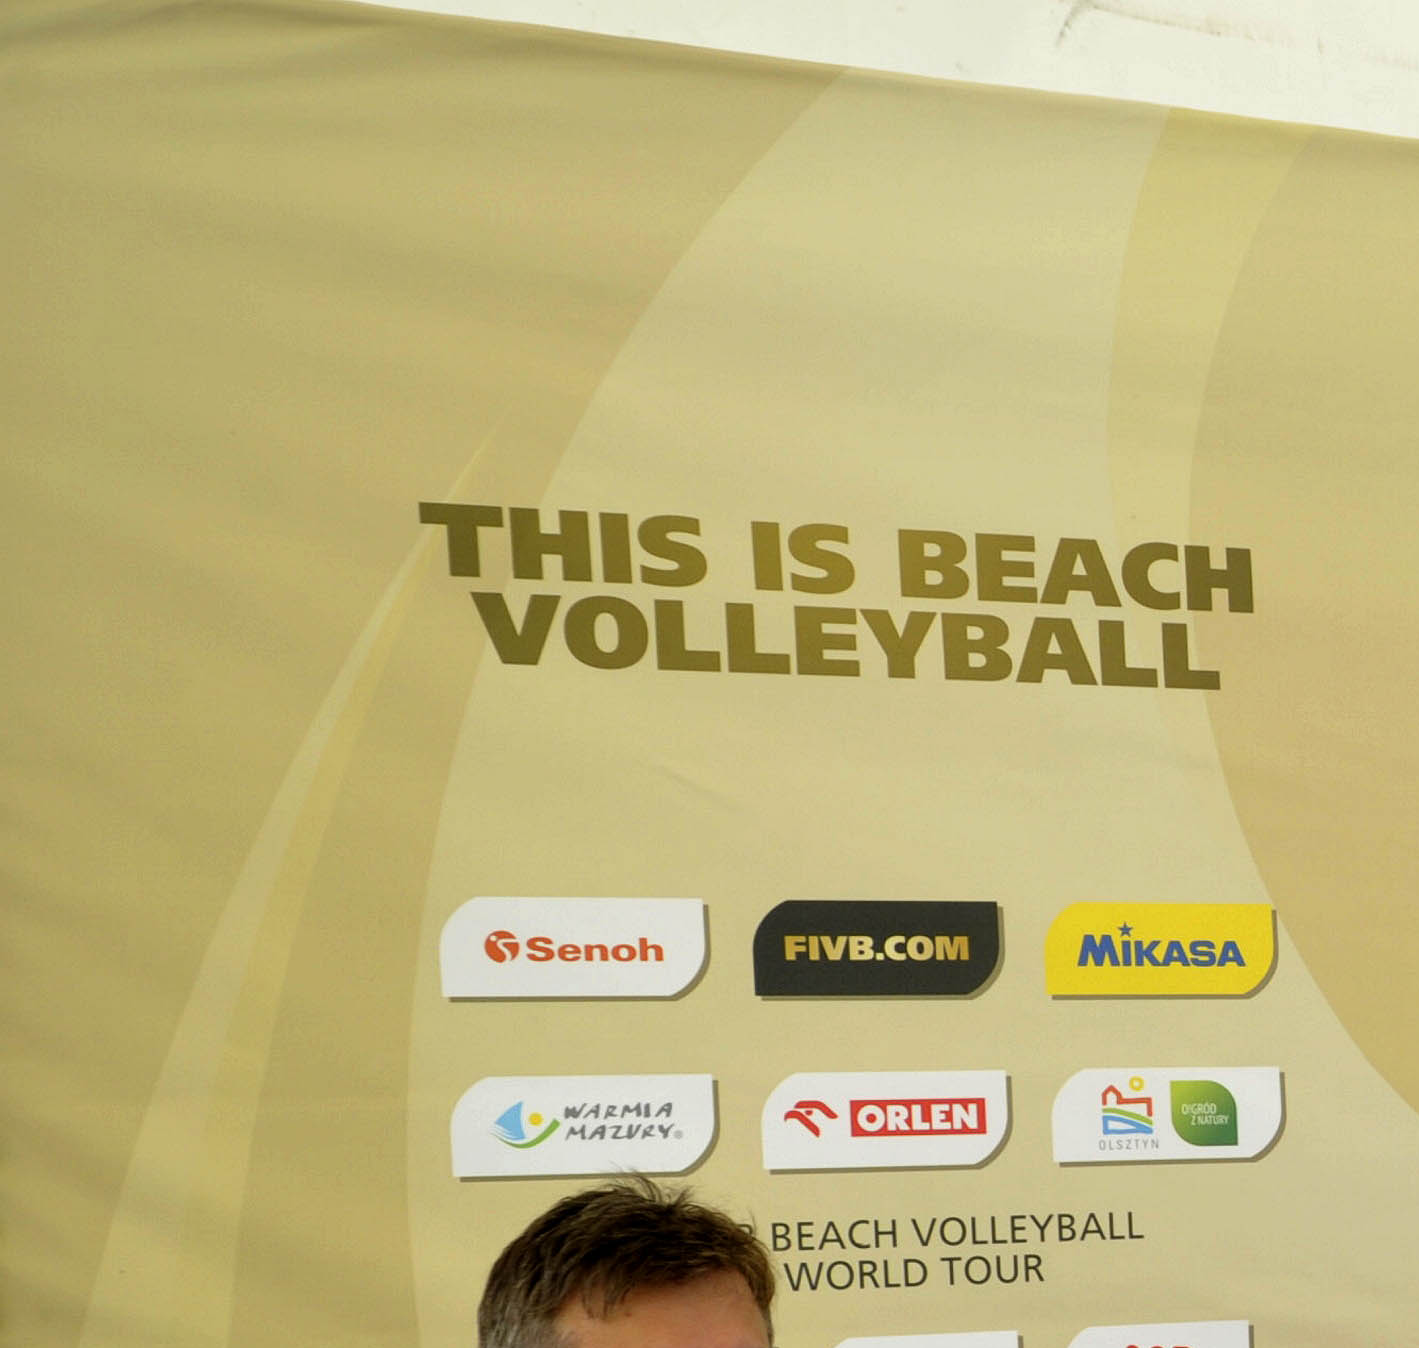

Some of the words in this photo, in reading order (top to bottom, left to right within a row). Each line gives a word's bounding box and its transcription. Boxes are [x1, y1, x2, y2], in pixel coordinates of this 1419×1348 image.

[419, 502, 708, 586] THIS
[752, 522, 855, 595] IS
[898, 529, 1255, 613] BEACH
[470, 592, 1222, 690] VOLLEYBALL
[526, 936, 664, 962] Senoh
[784, 934, 970, 961] FIVB.COM
[564, 1102, 672, 1121] WARMIA
[857, 1104, 978, 1132] ORLEN
[1099, 1139, 1159, 1150] OLSZTYN
[772, 1219, 898, 1251] BEACH
[912, 1212, 1145, 1247] VOLLEYBALL
[784, 1260, 928, 1291] WORLD
[942, 1254, 1045, 1285] TOUR
